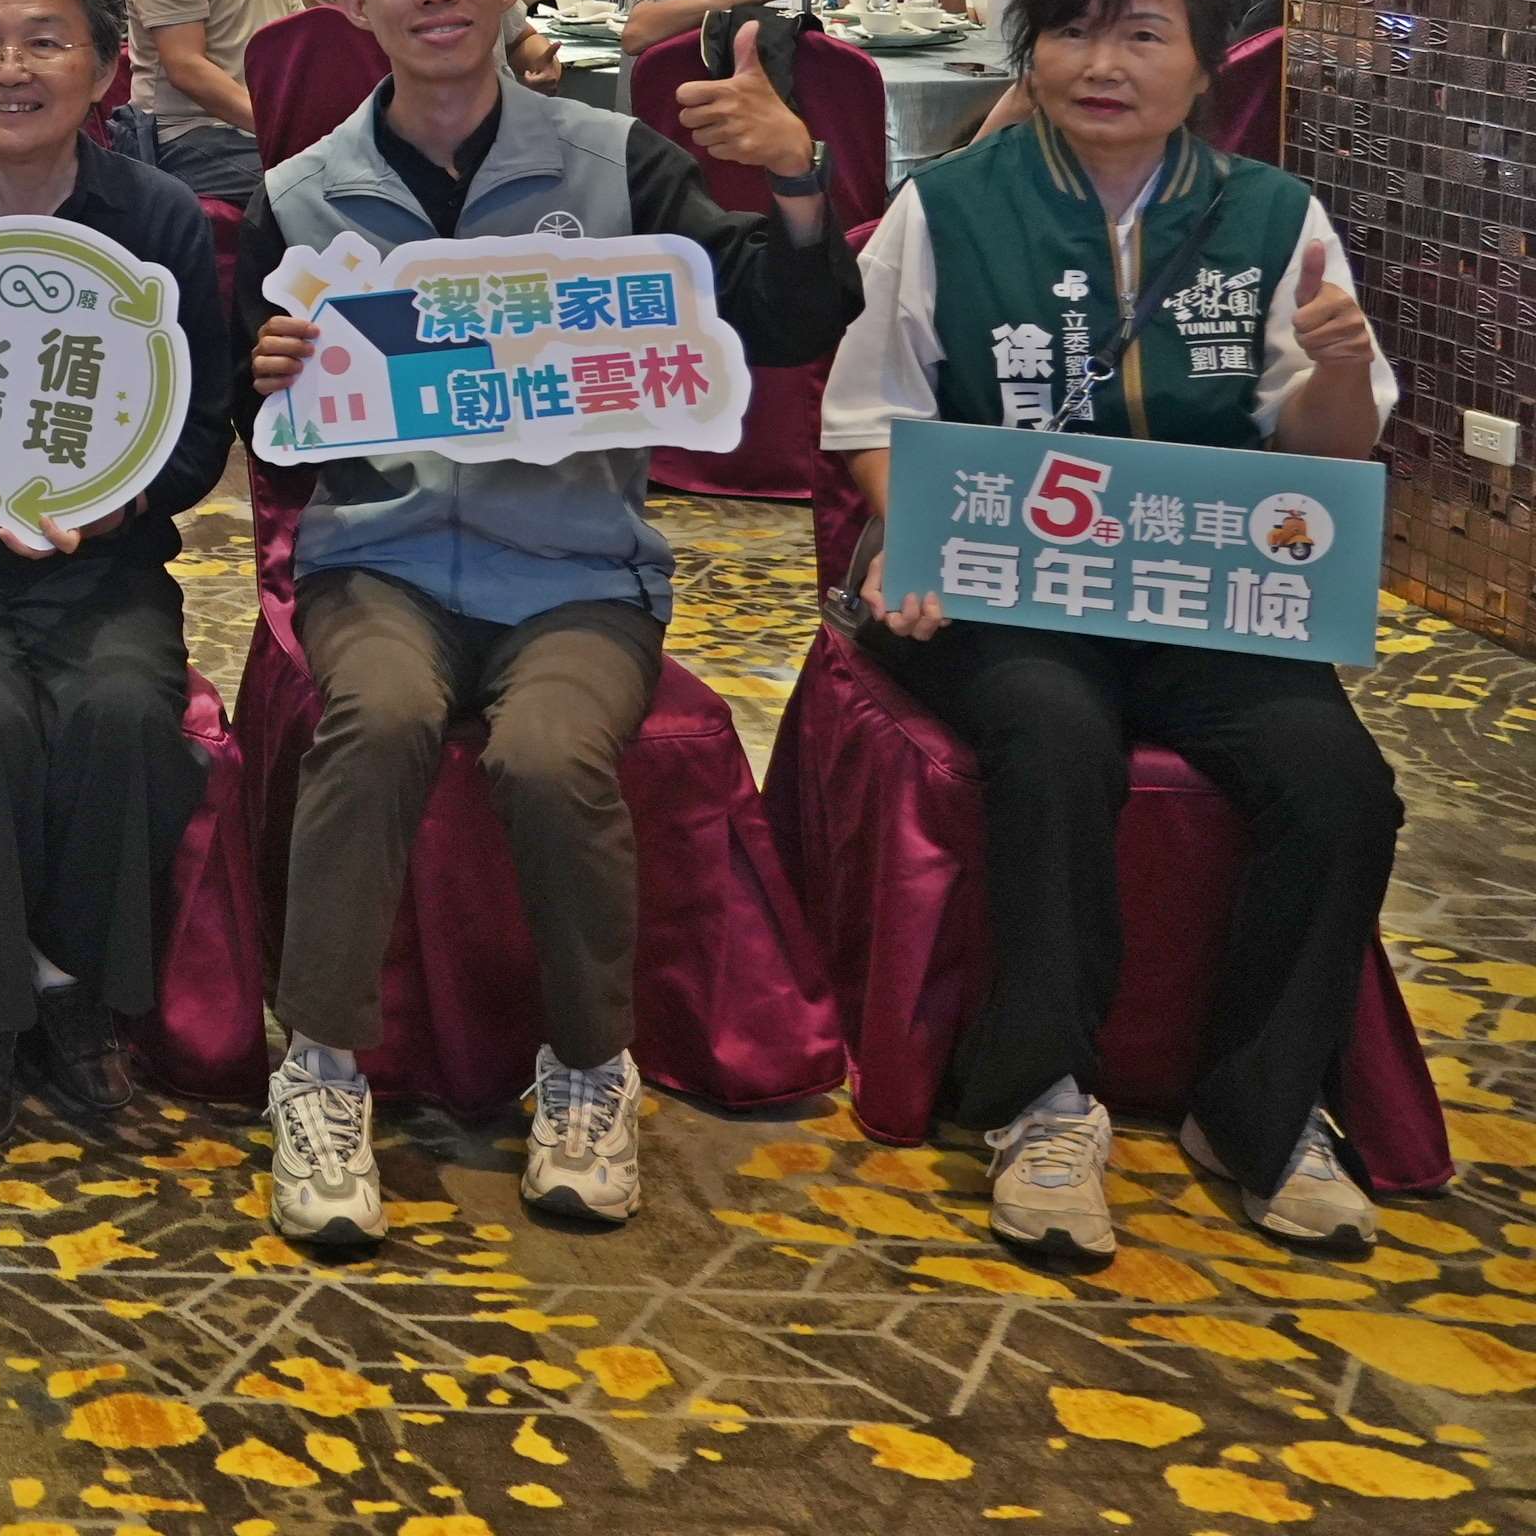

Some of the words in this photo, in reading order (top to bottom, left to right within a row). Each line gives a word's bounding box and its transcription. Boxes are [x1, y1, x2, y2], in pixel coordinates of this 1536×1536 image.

[416, 272, 678, 340] 潔淨家園
[1176, 320, 1238, 336] YUNLIN
[450, 343, 710, 426] 韌性雲林
[1190, 344, 1255, 372] 劉建
[22, 327, 106, 470] 循環
[939, 537, 1313, 642] 每年定檢
